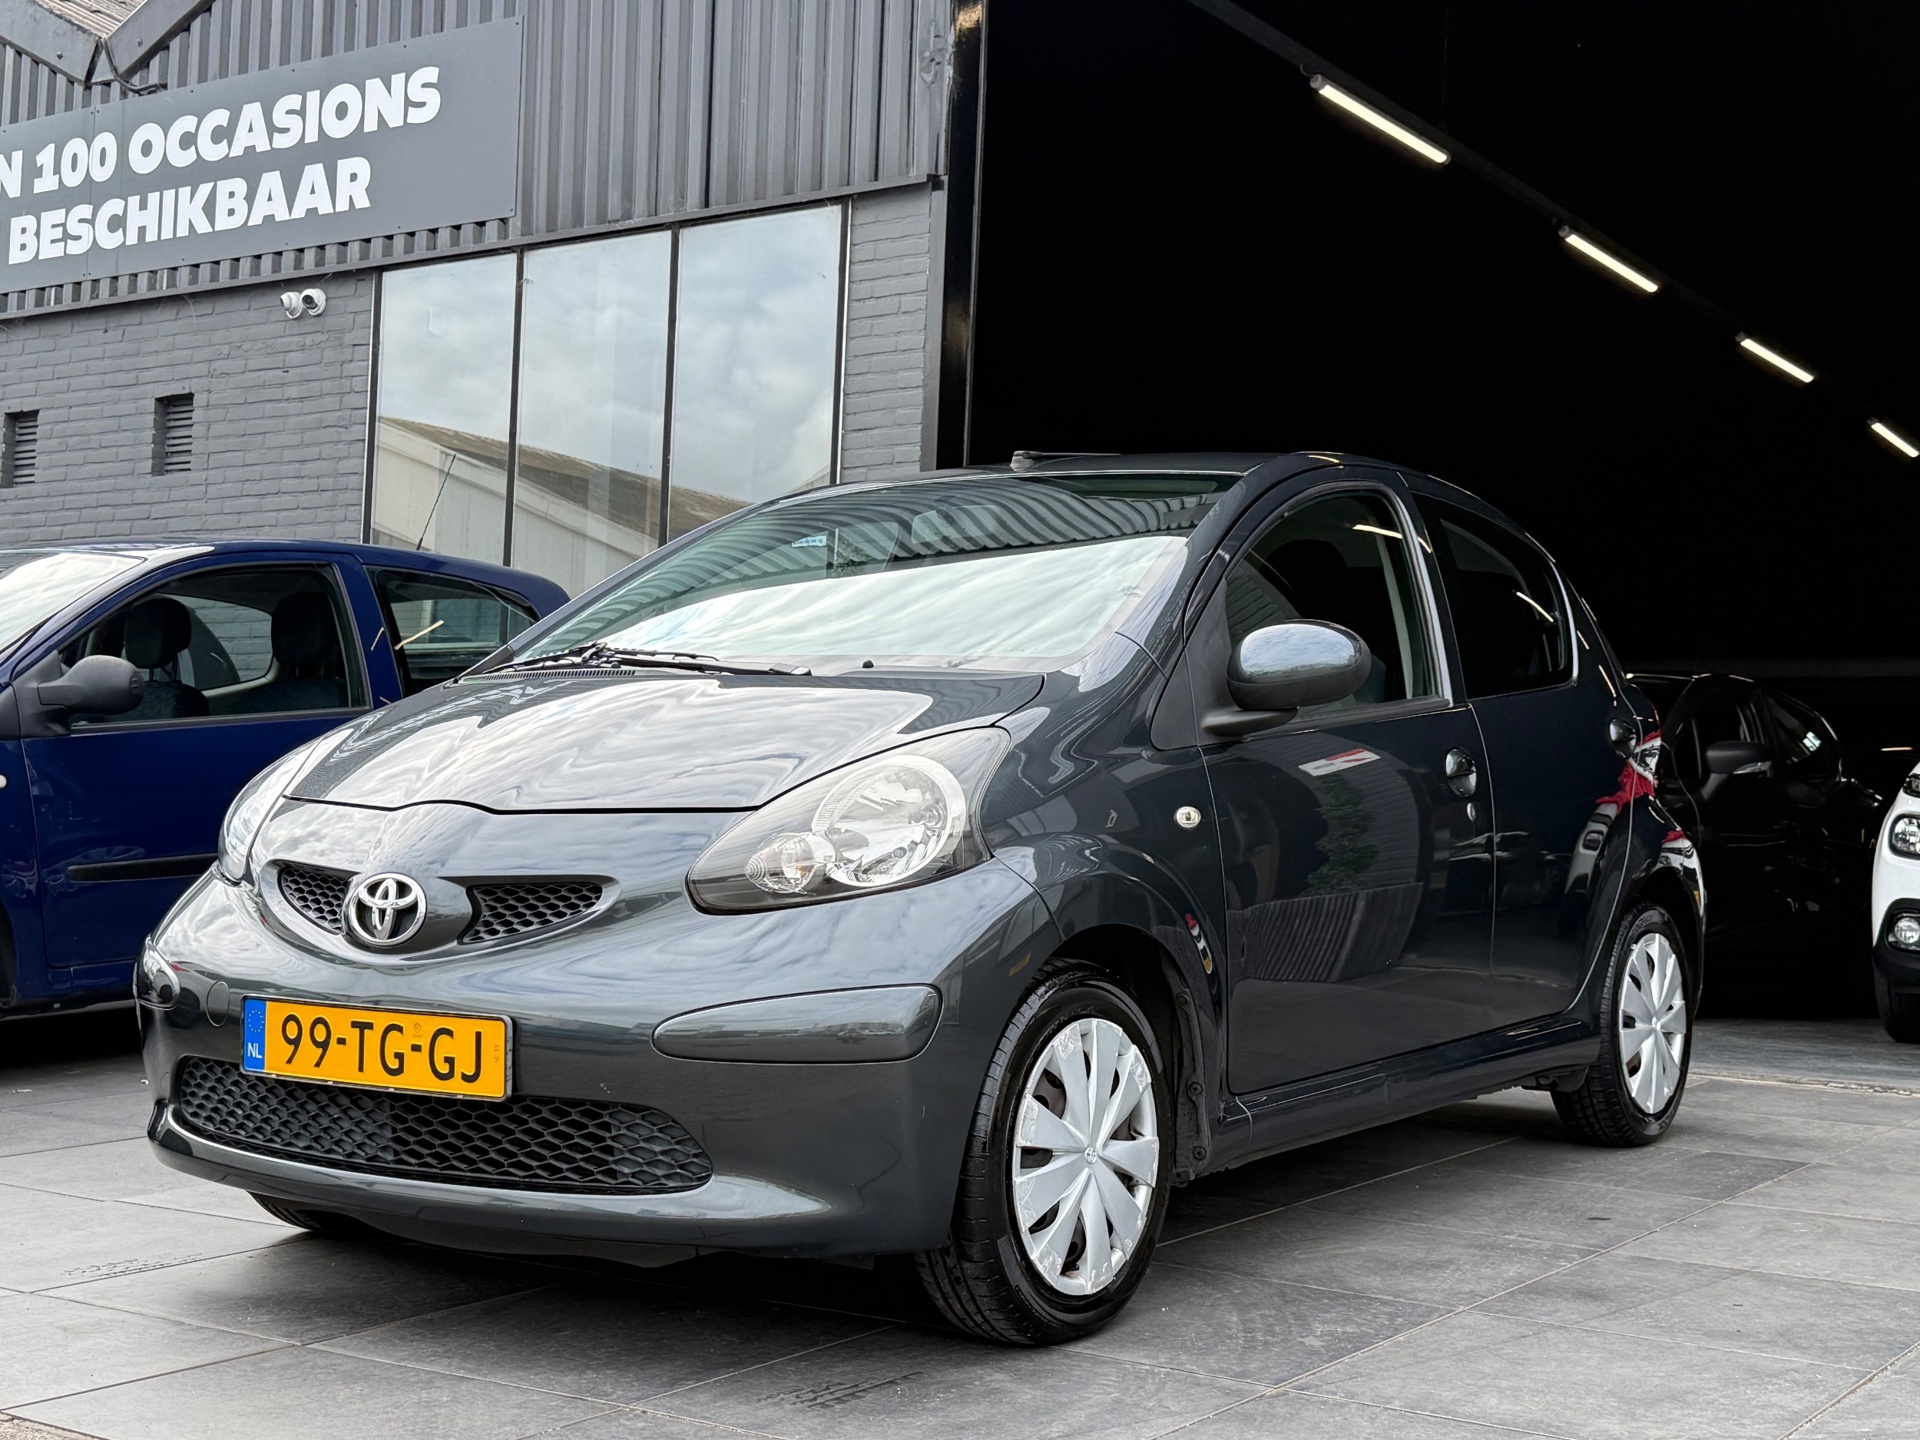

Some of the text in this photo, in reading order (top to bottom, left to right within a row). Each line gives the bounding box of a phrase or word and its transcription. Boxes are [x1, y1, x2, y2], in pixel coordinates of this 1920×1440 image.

[33, 132, 117, 194] 100
[128, 66, 441, 174] OCCASIONS
[8, 157, 371, 265] BESCHIKBAAR
[247, 1042, 263, 1059] NL
[281, 1014, 482, 1083] 99-TG-GJ
